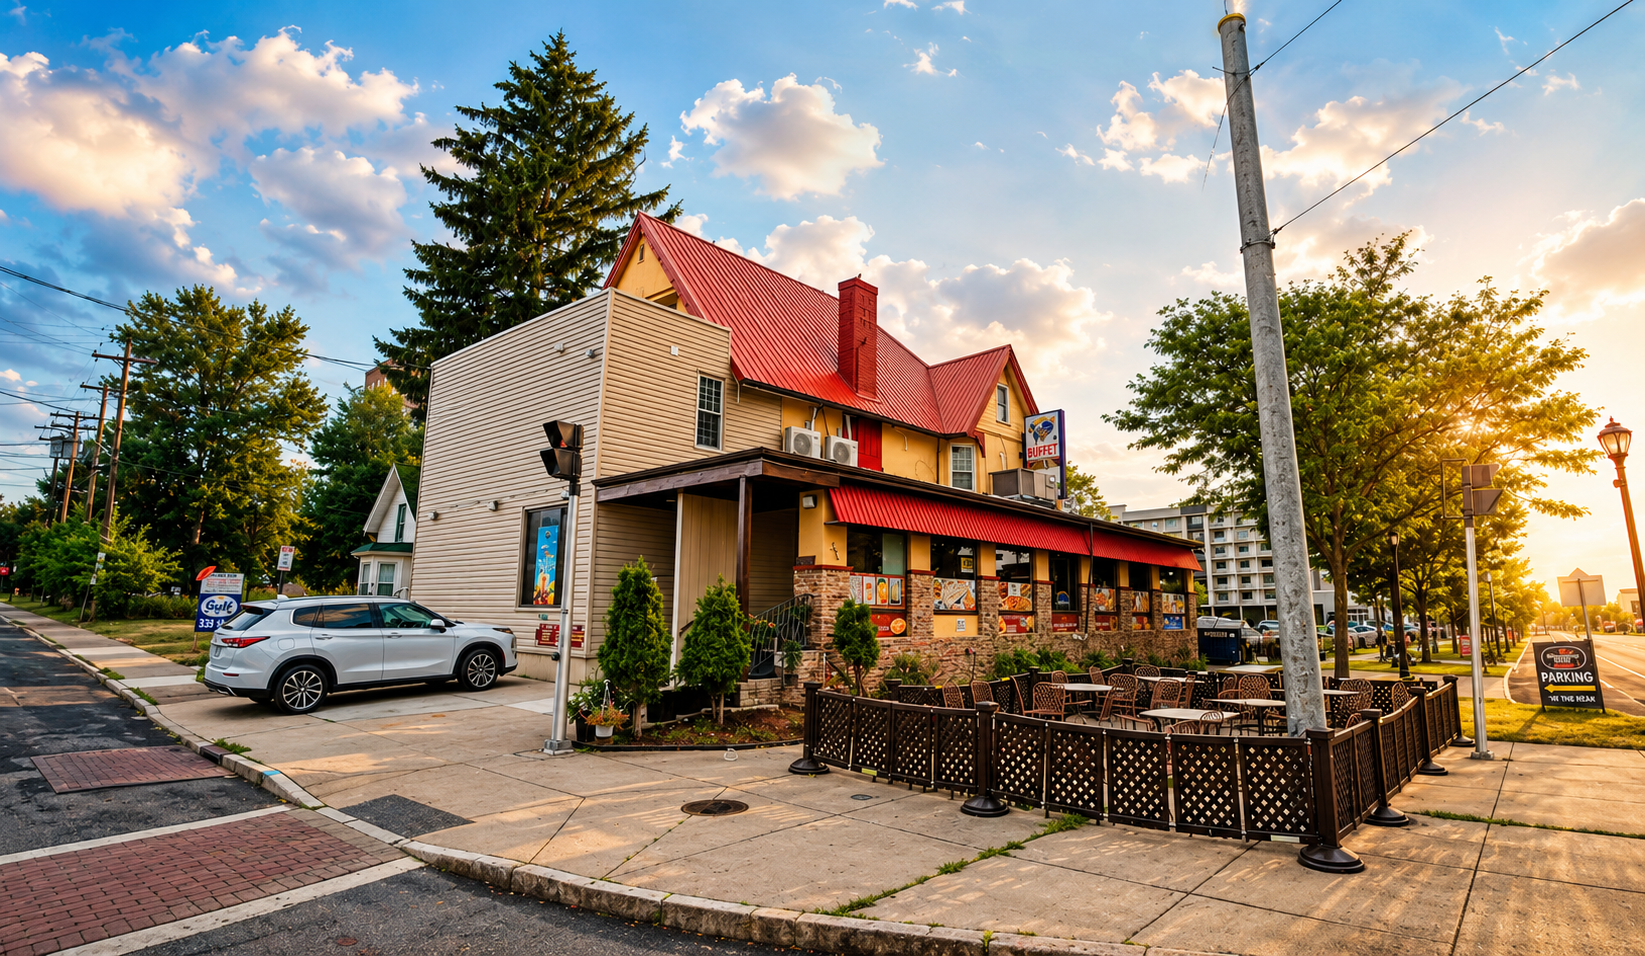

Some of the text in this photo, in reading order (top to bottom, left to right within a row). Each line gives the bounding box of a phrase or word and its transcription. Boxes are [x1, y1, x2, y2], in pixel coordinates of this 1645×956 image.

[1027, 443, 1058, 458] BUFFET
[204, 599, 234, 614] Gulf
[1541, 671, 1594, 683] PARKING
